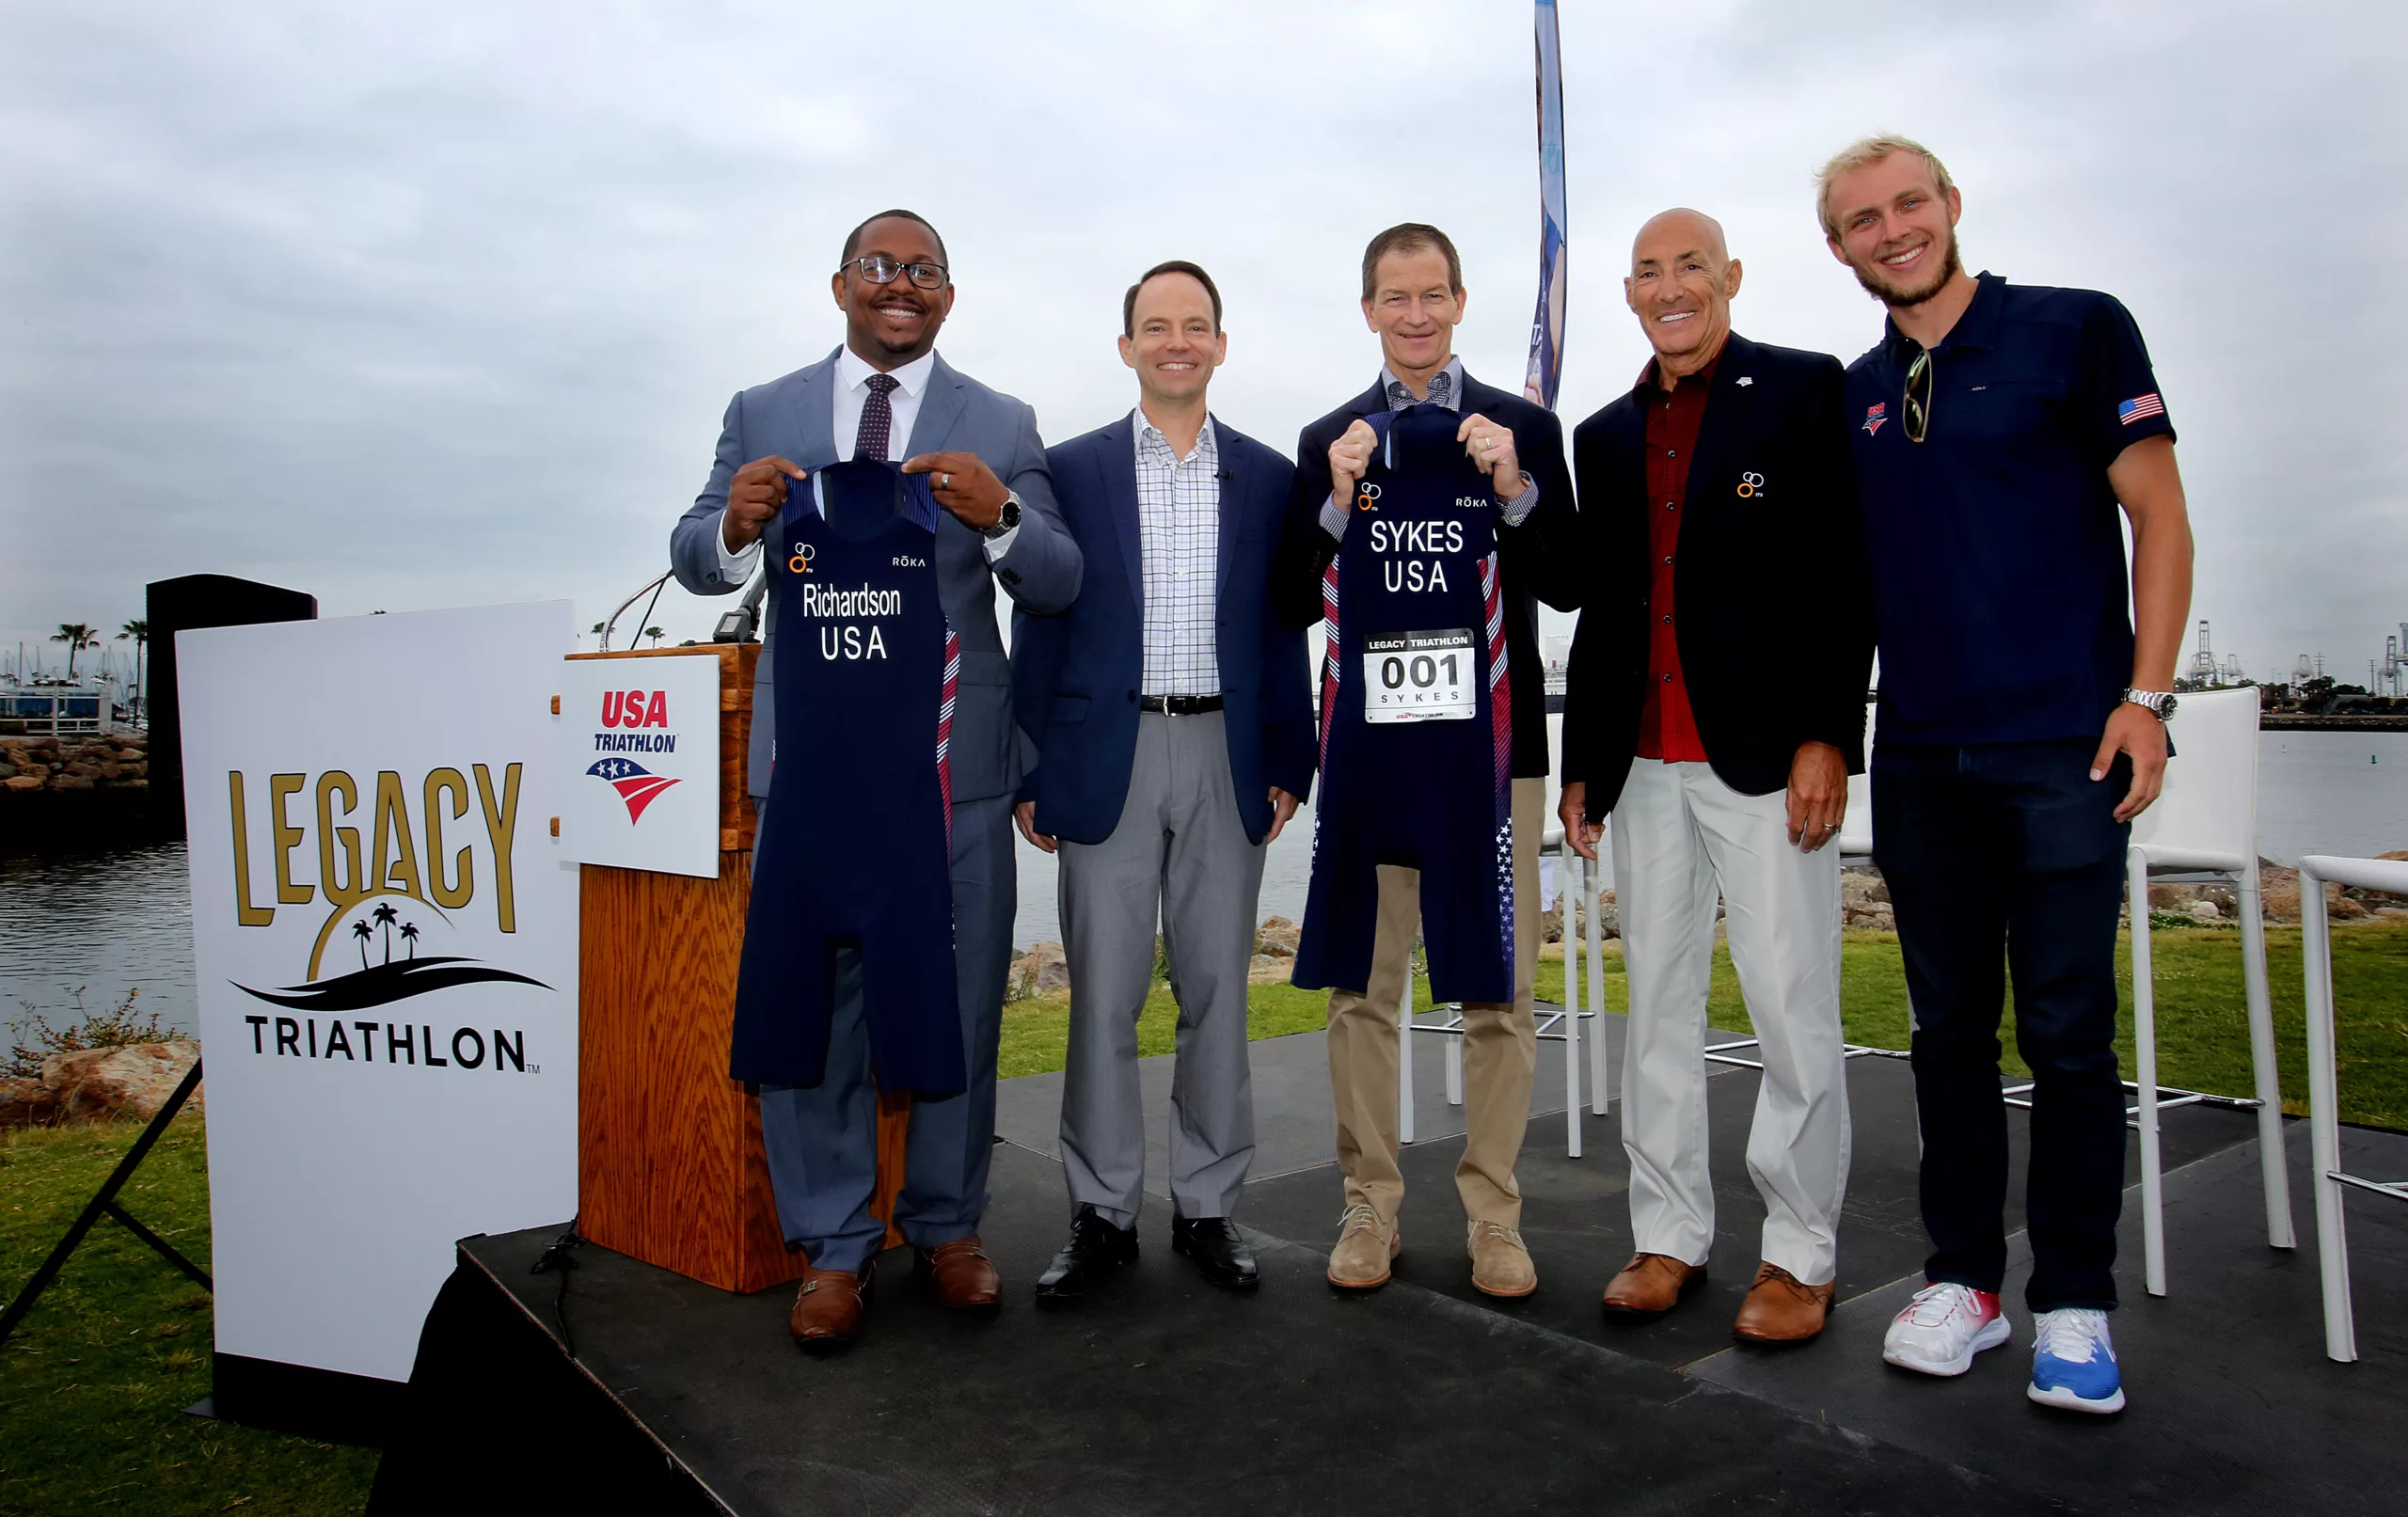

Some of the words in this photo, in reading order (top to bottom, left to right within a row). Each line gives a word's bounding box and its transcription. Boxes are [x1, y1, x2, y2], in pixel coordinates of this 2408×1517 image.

[1370, 520, 1464, 553] SYKES
[1385, 561, 1449, 593] USA
[803, 582, 901, 618] Richardson
[821, 625, 887, 660] USA
[1369, 640, 1406, 650] LEGACY
[1410, 636, 1468, 648] TRIATHLON
[1381, 654, 1459, 689] 001
[601, 689, 668, 729] USA
[1381, 691, 1459, 703] SYKES
[594, 734, 676, 753] TRIATHLON
[229, 762, 523, 934] LEGACY
[245, 1015, 526, 1073] TRIATHLON
